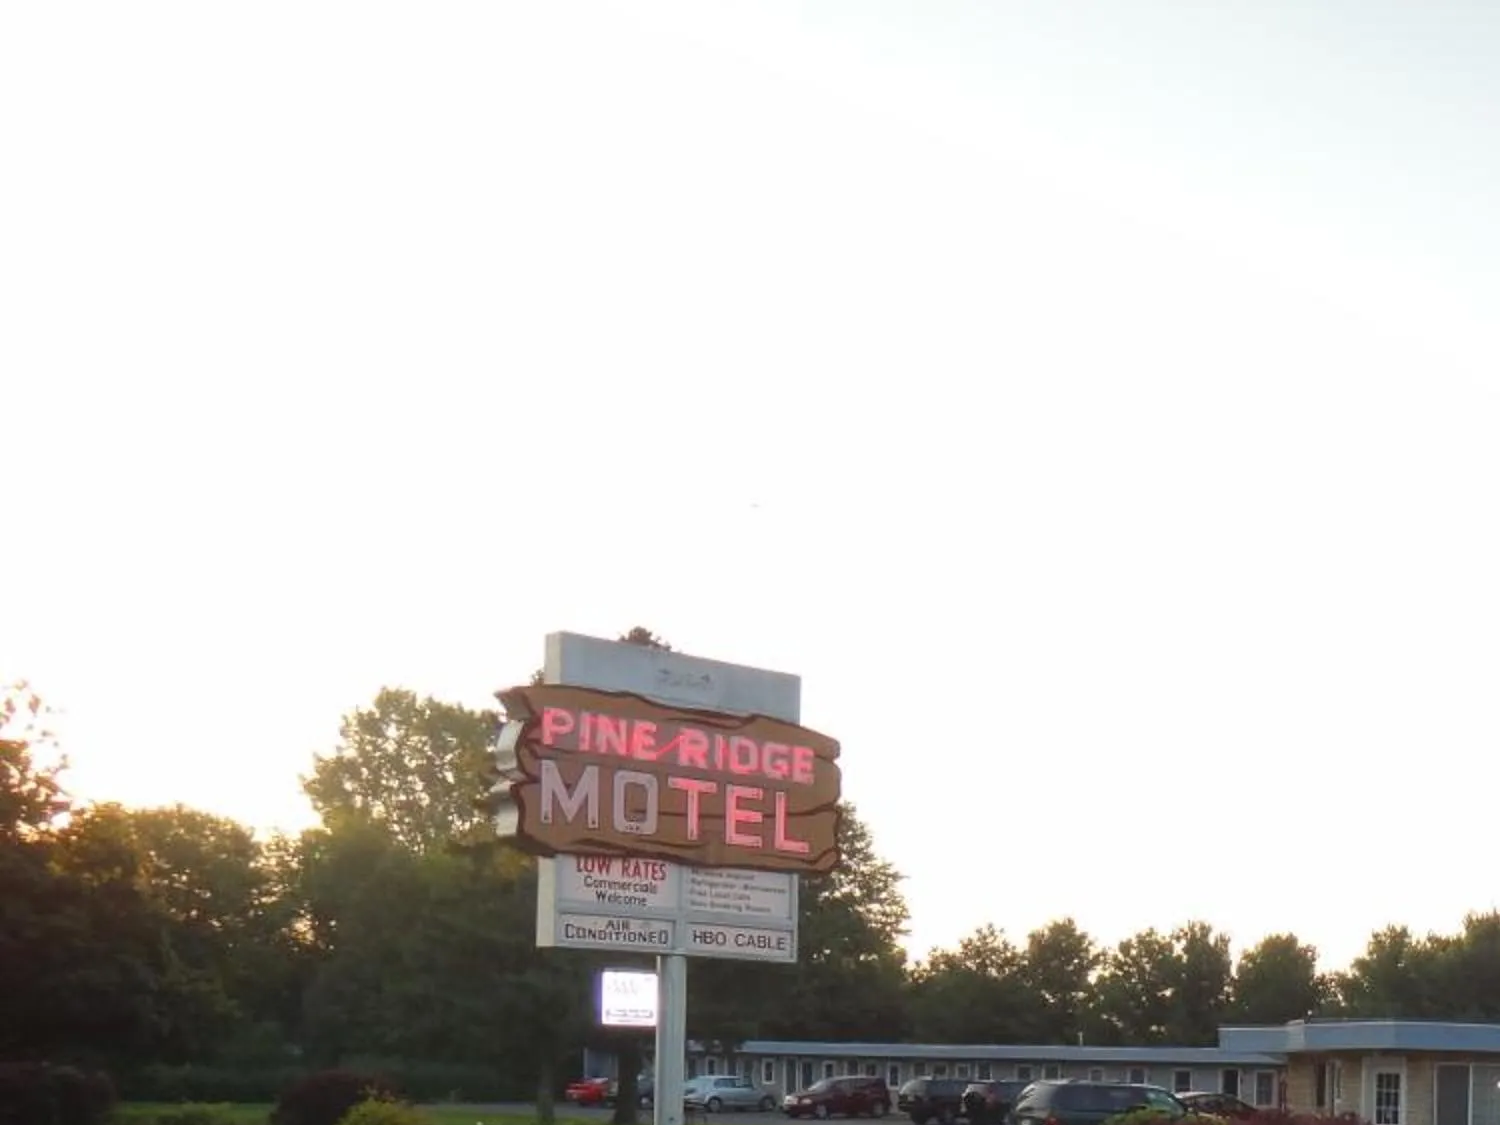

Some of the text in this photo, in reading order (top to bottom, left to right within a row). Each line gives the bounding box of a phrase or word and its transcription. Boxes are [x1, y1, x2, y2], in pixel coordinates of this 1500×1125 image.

[541, 706, 815, 784] PINE RIDGE
[540, 759, 810, 853] MOTEL
[575, 856, 611, 876] LOW
[621, 857, 667, 881] RATES
[595, 891, 648, 906] Welcome
[692, 931, 786, 951] HBO CABLE
